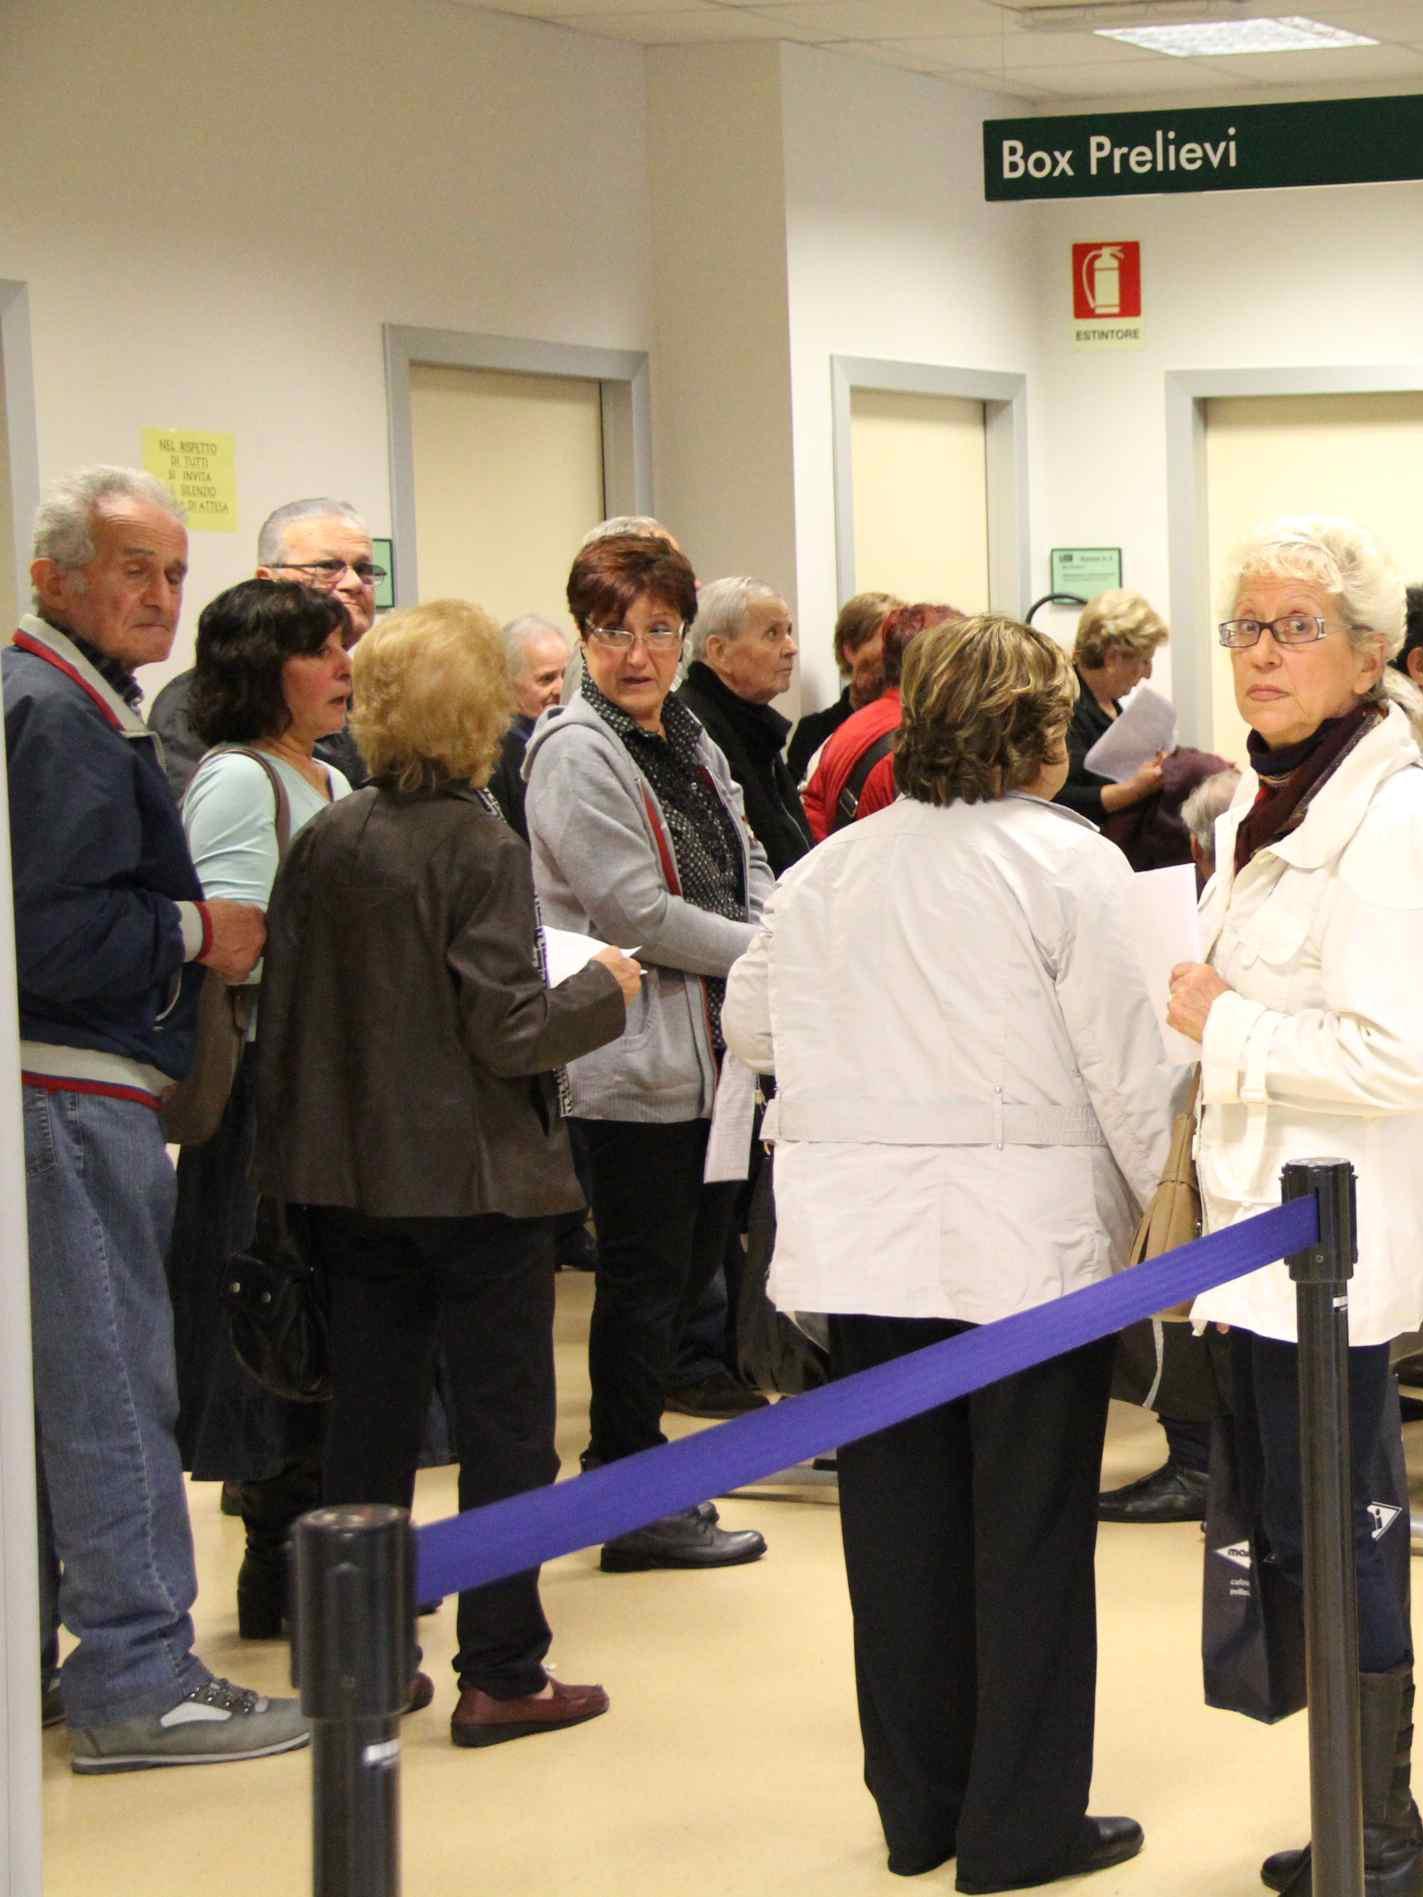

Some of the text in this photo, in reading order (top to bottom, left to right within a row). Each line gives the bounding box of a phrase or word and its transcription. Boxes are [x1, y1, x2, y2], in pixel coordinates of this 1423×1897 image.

[1002, 126, 1237, 179] Box Prelievi
[1075, 328, 1140, 342] ESTINTORE
[159, 439, 175, 452] NEL
[183, 470, 212, 481] INVITA
